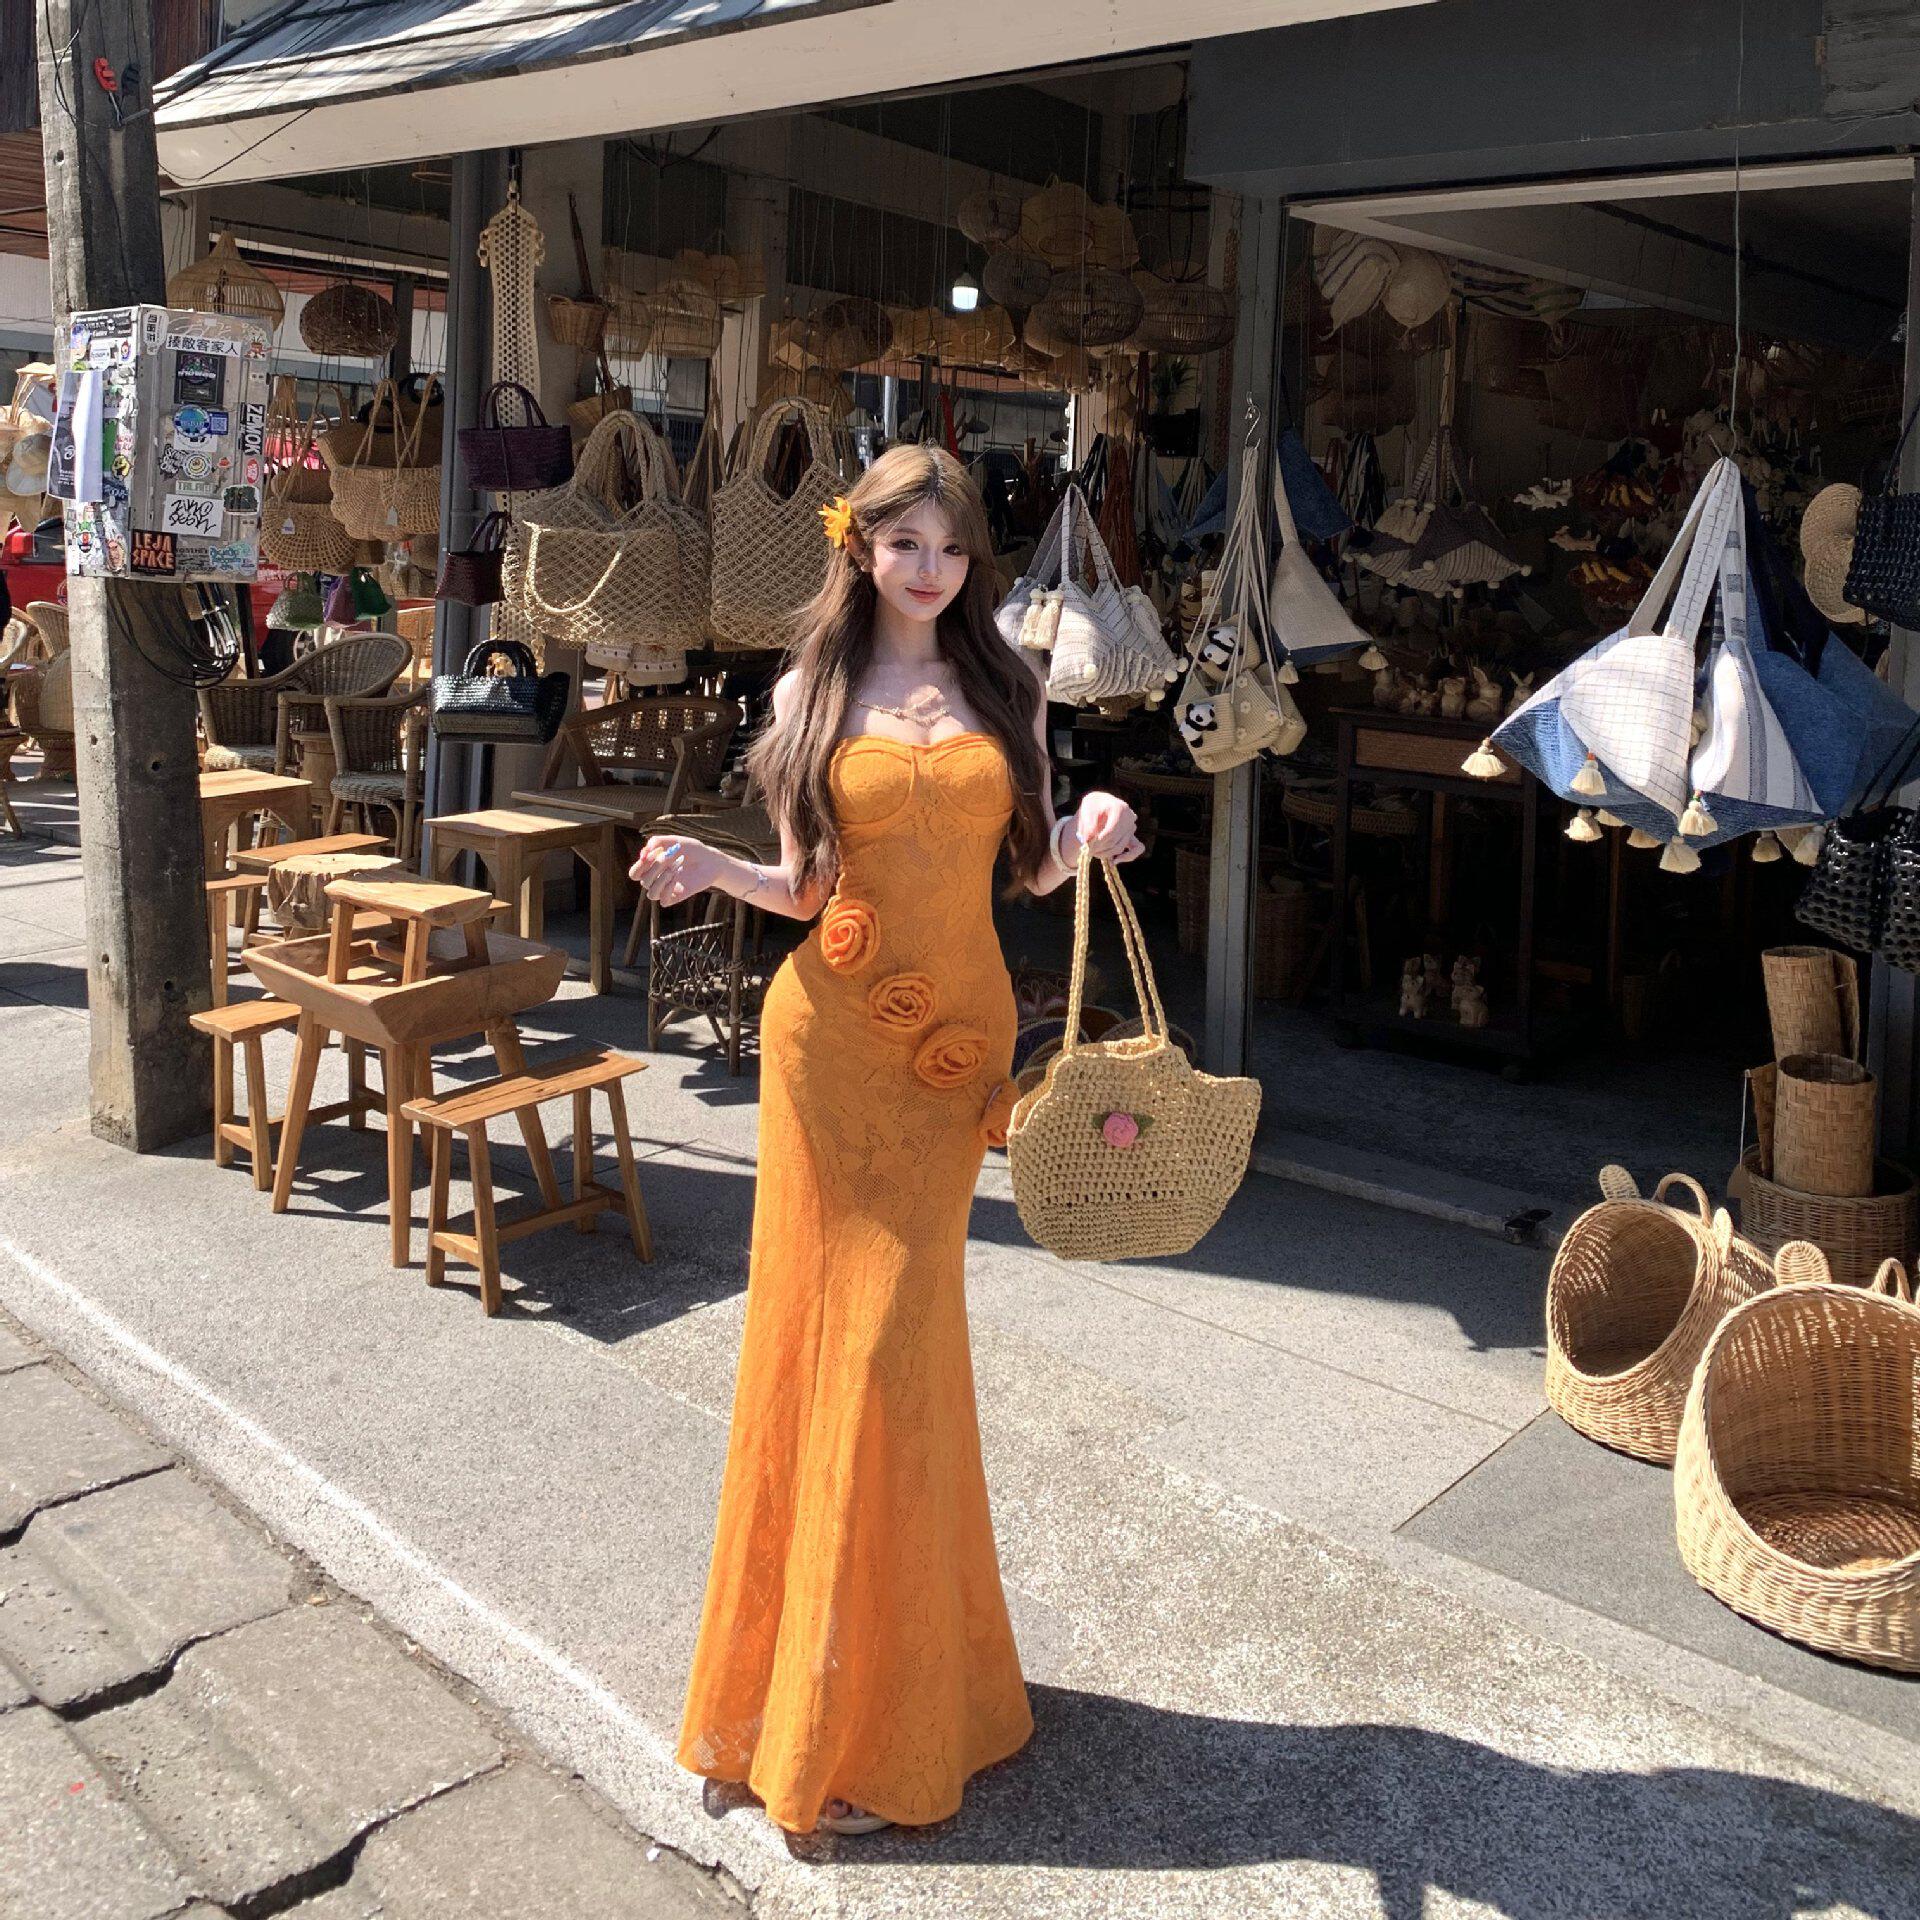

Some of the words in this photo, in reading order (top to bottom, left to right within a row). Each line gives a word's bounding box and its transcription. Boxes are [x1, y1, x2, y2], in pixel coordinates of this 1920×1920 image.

[244, 404, 264, 455] ZEMOK
[134, 532, 173, 552] LEJA
[132, 549, 175, 569] SPACE
